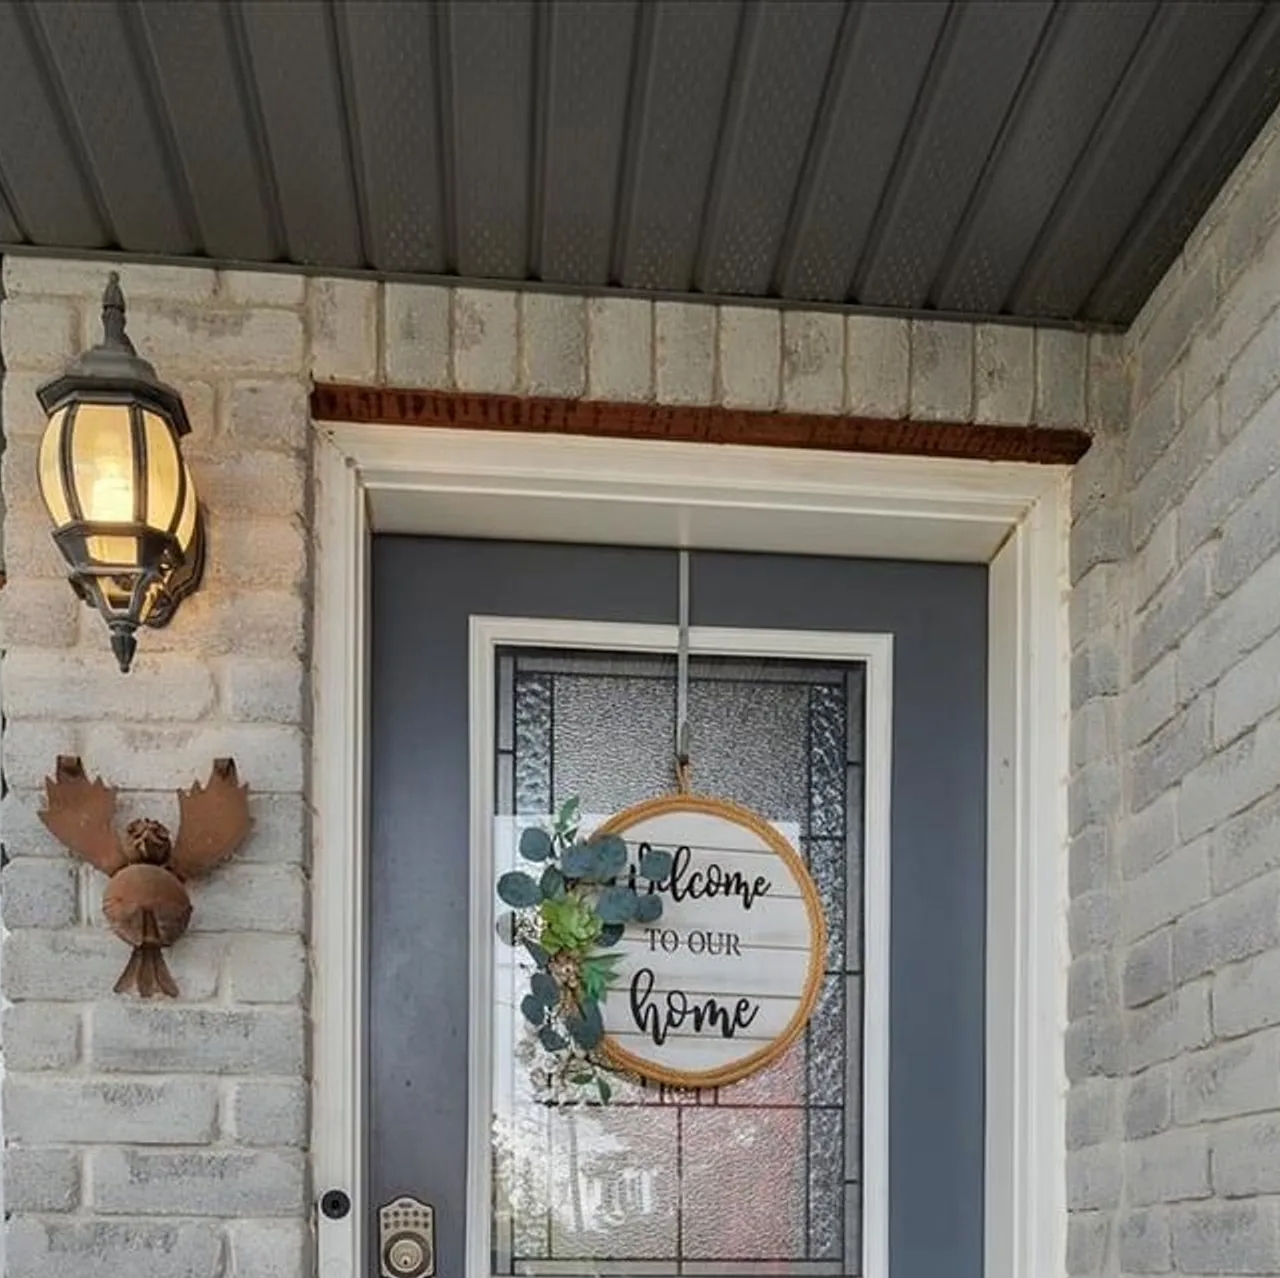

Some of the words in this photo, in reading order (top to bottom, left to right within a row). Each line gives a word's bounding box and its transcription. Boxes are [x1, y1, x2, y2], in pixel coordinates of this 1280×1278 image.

[644, 928, 679, 951] TO
[687, 930, 741, 956] OUR
[629, 967, 760, 1046] home
